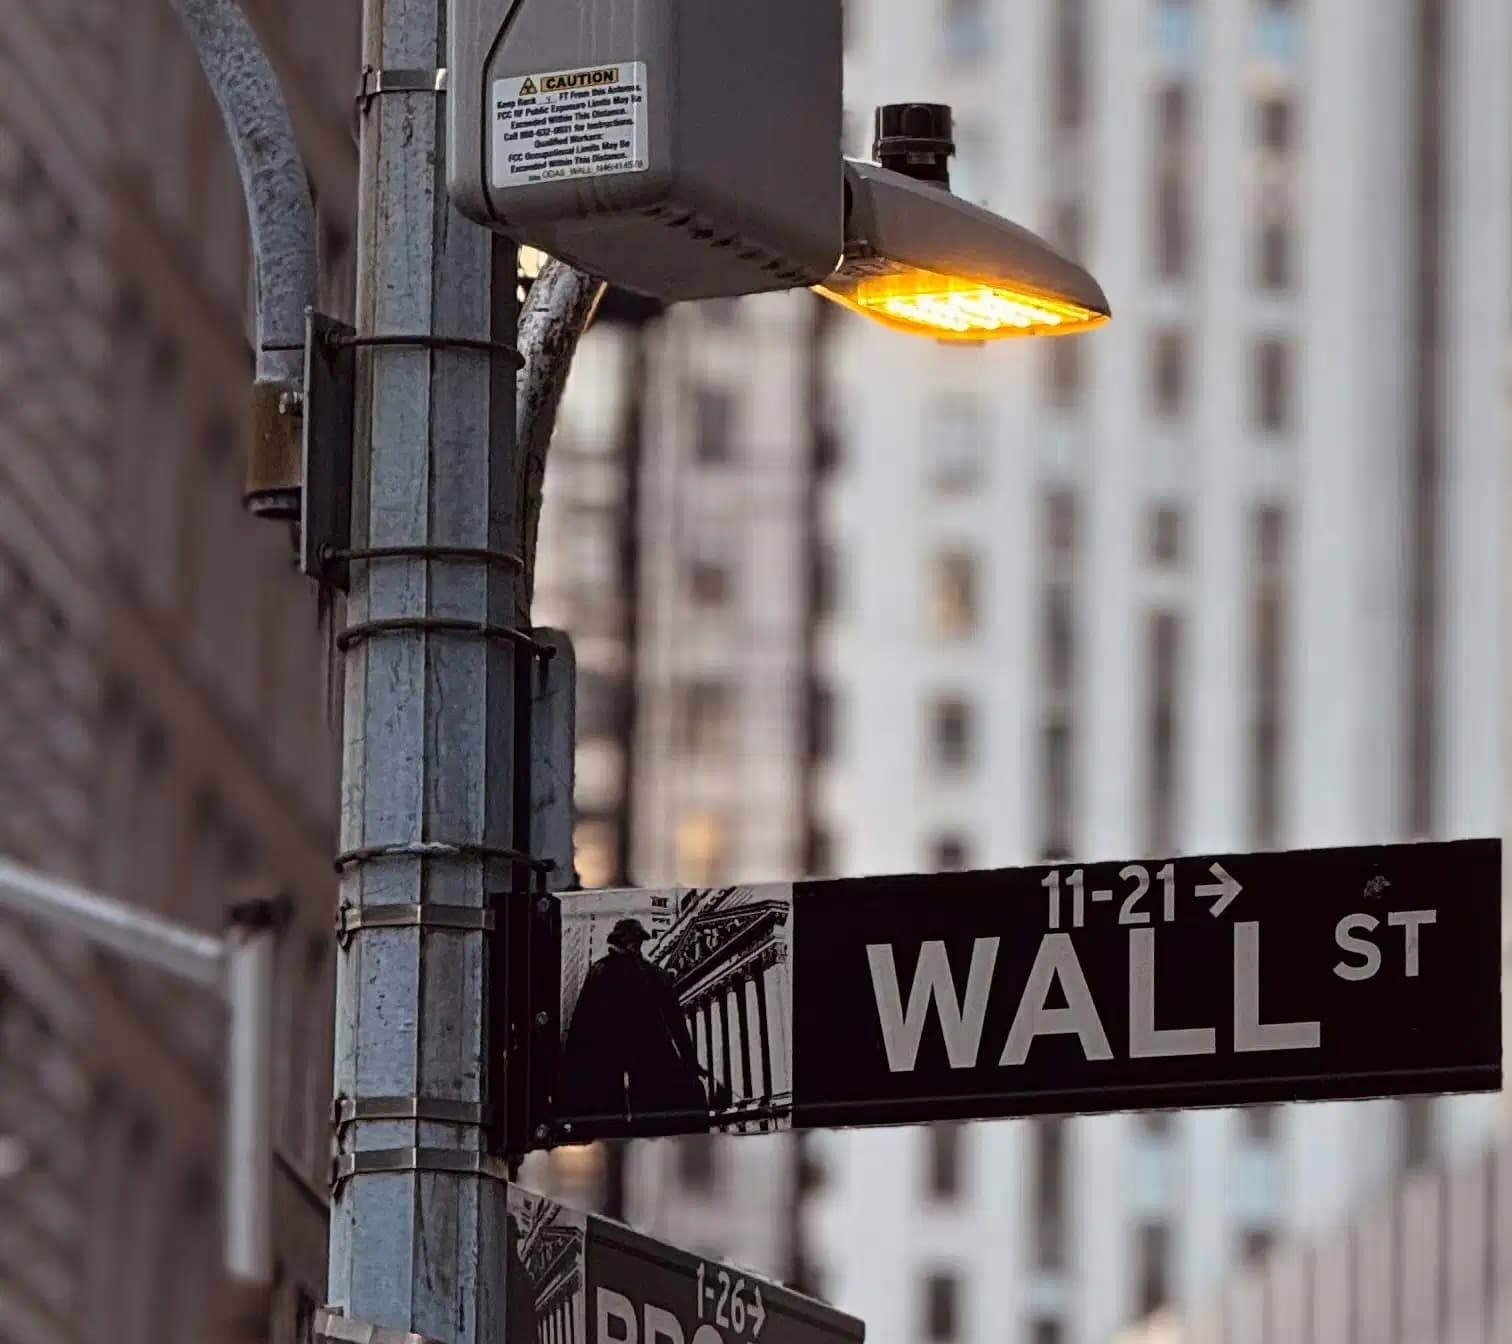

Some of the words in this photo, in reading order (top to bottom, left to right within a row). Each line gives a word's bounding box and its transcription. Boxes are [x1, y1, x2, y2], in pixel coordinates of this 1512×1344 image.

[546, 70, 614, 89] CAUTION
[559, 92, 568, 100] FT
[497, 110, 512, 120] FCC
[525, 106, 549, 117] Public
[613, 96, 629, 105] May
[575, 111, 590, 120] This
[508, 153, 523, 162] FCC
[620, 139, 630, 148] Be
[1040, 863, 1177, 930] 11-21
[866, 921, 1321, 1073] WALL
[1331, 908, 1438, 982] ST
[696, 1262, 746, 1334] 1-26
